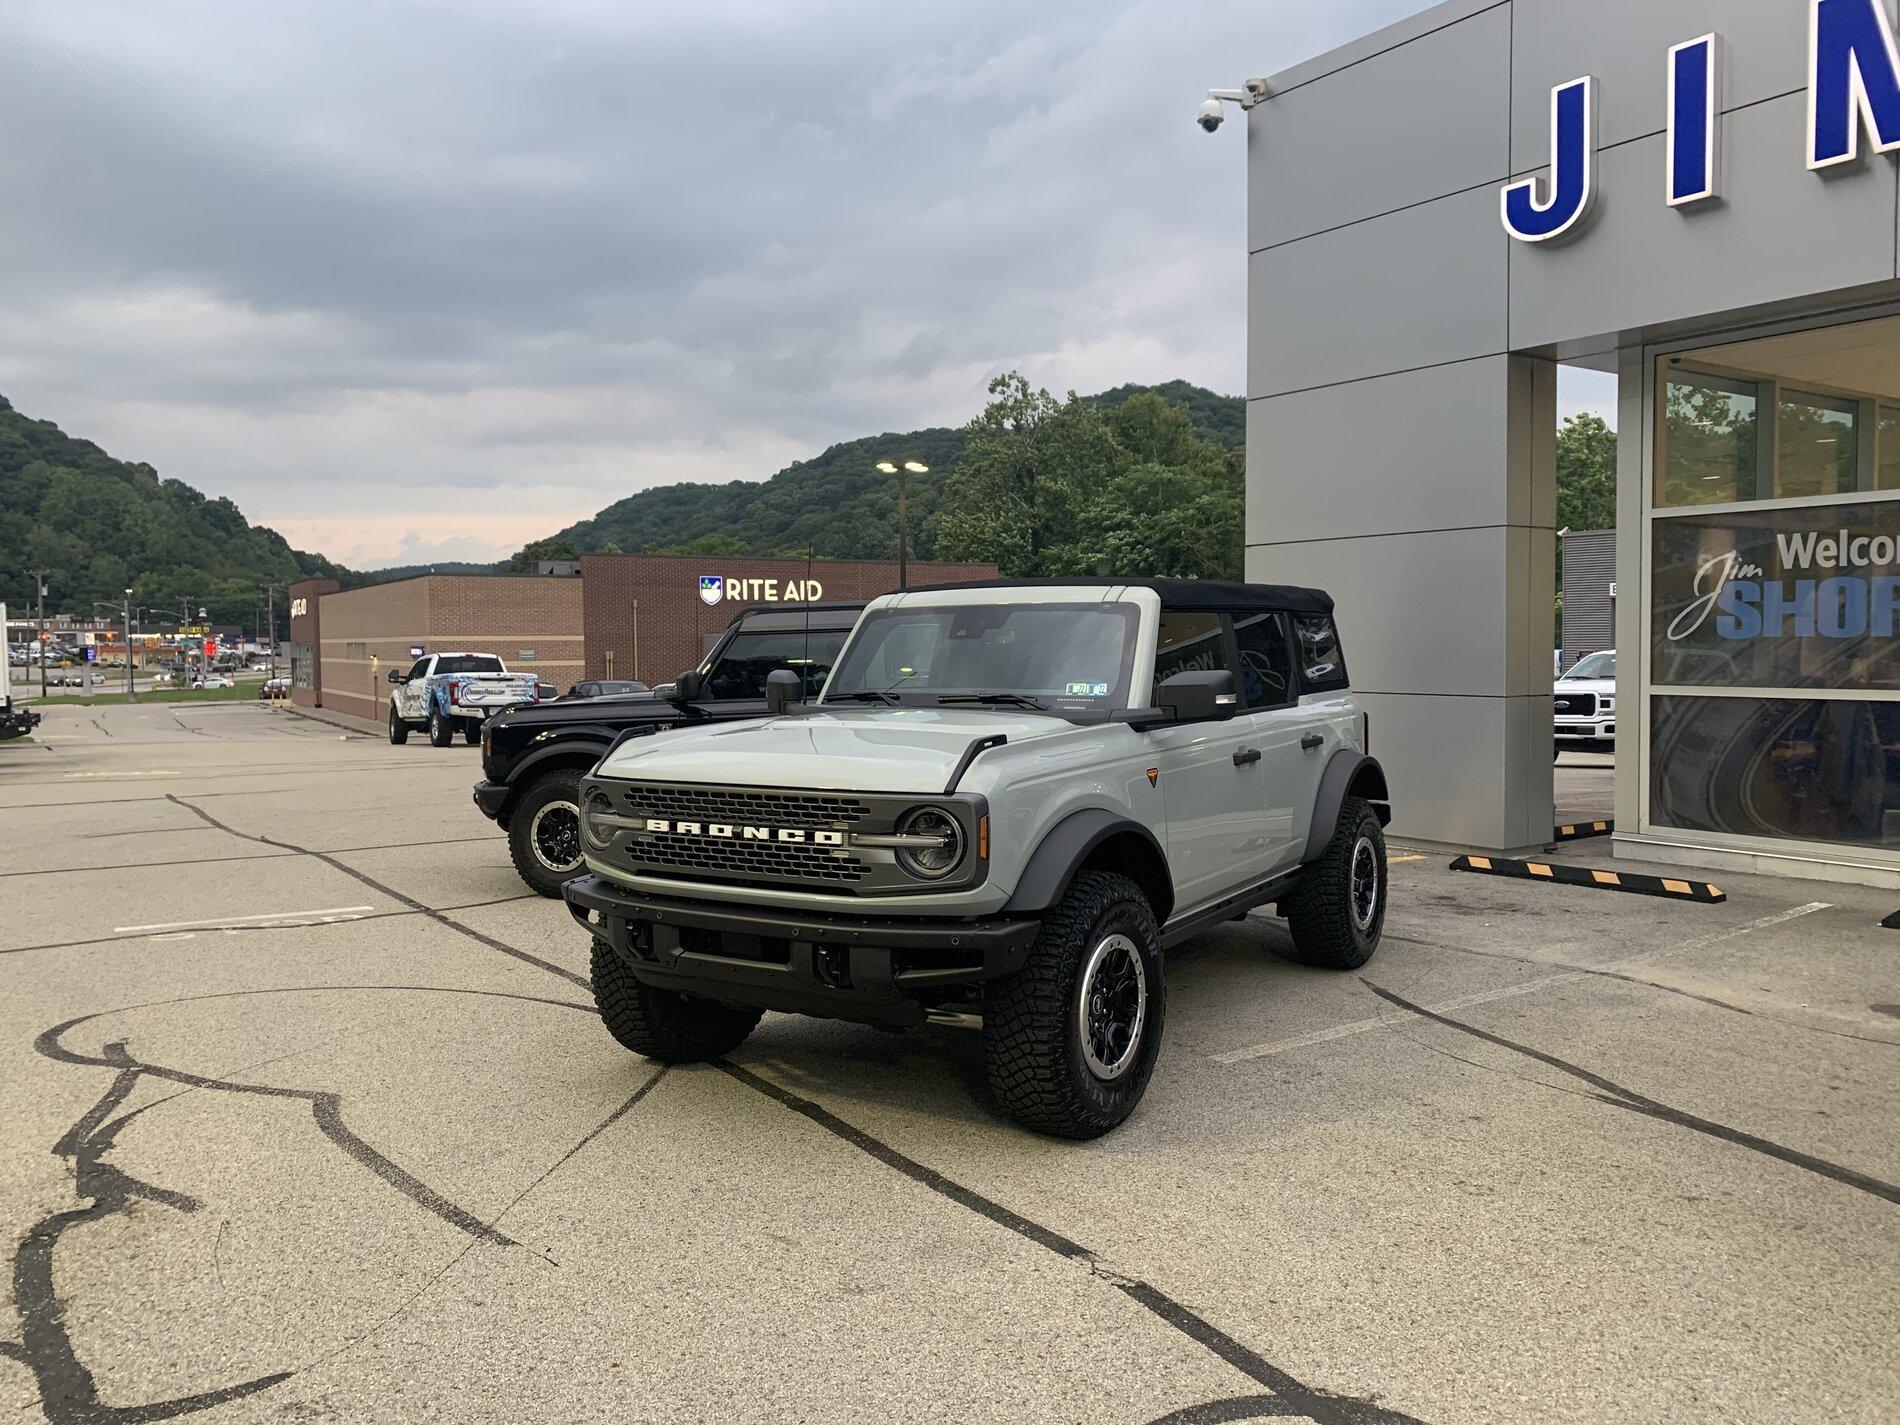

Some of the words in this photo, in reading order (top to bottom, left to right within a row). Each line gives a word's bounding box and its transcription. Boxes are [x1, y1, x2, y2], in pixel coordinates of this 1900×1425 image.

[1776, 529, 1900, 570] Welco
[726, 578, 779, 601] RITE
[783, 580, 823, 602] AID
[1666, 549, 1763, 641] Jim
[646, 819, 843, 845] BRONCO
